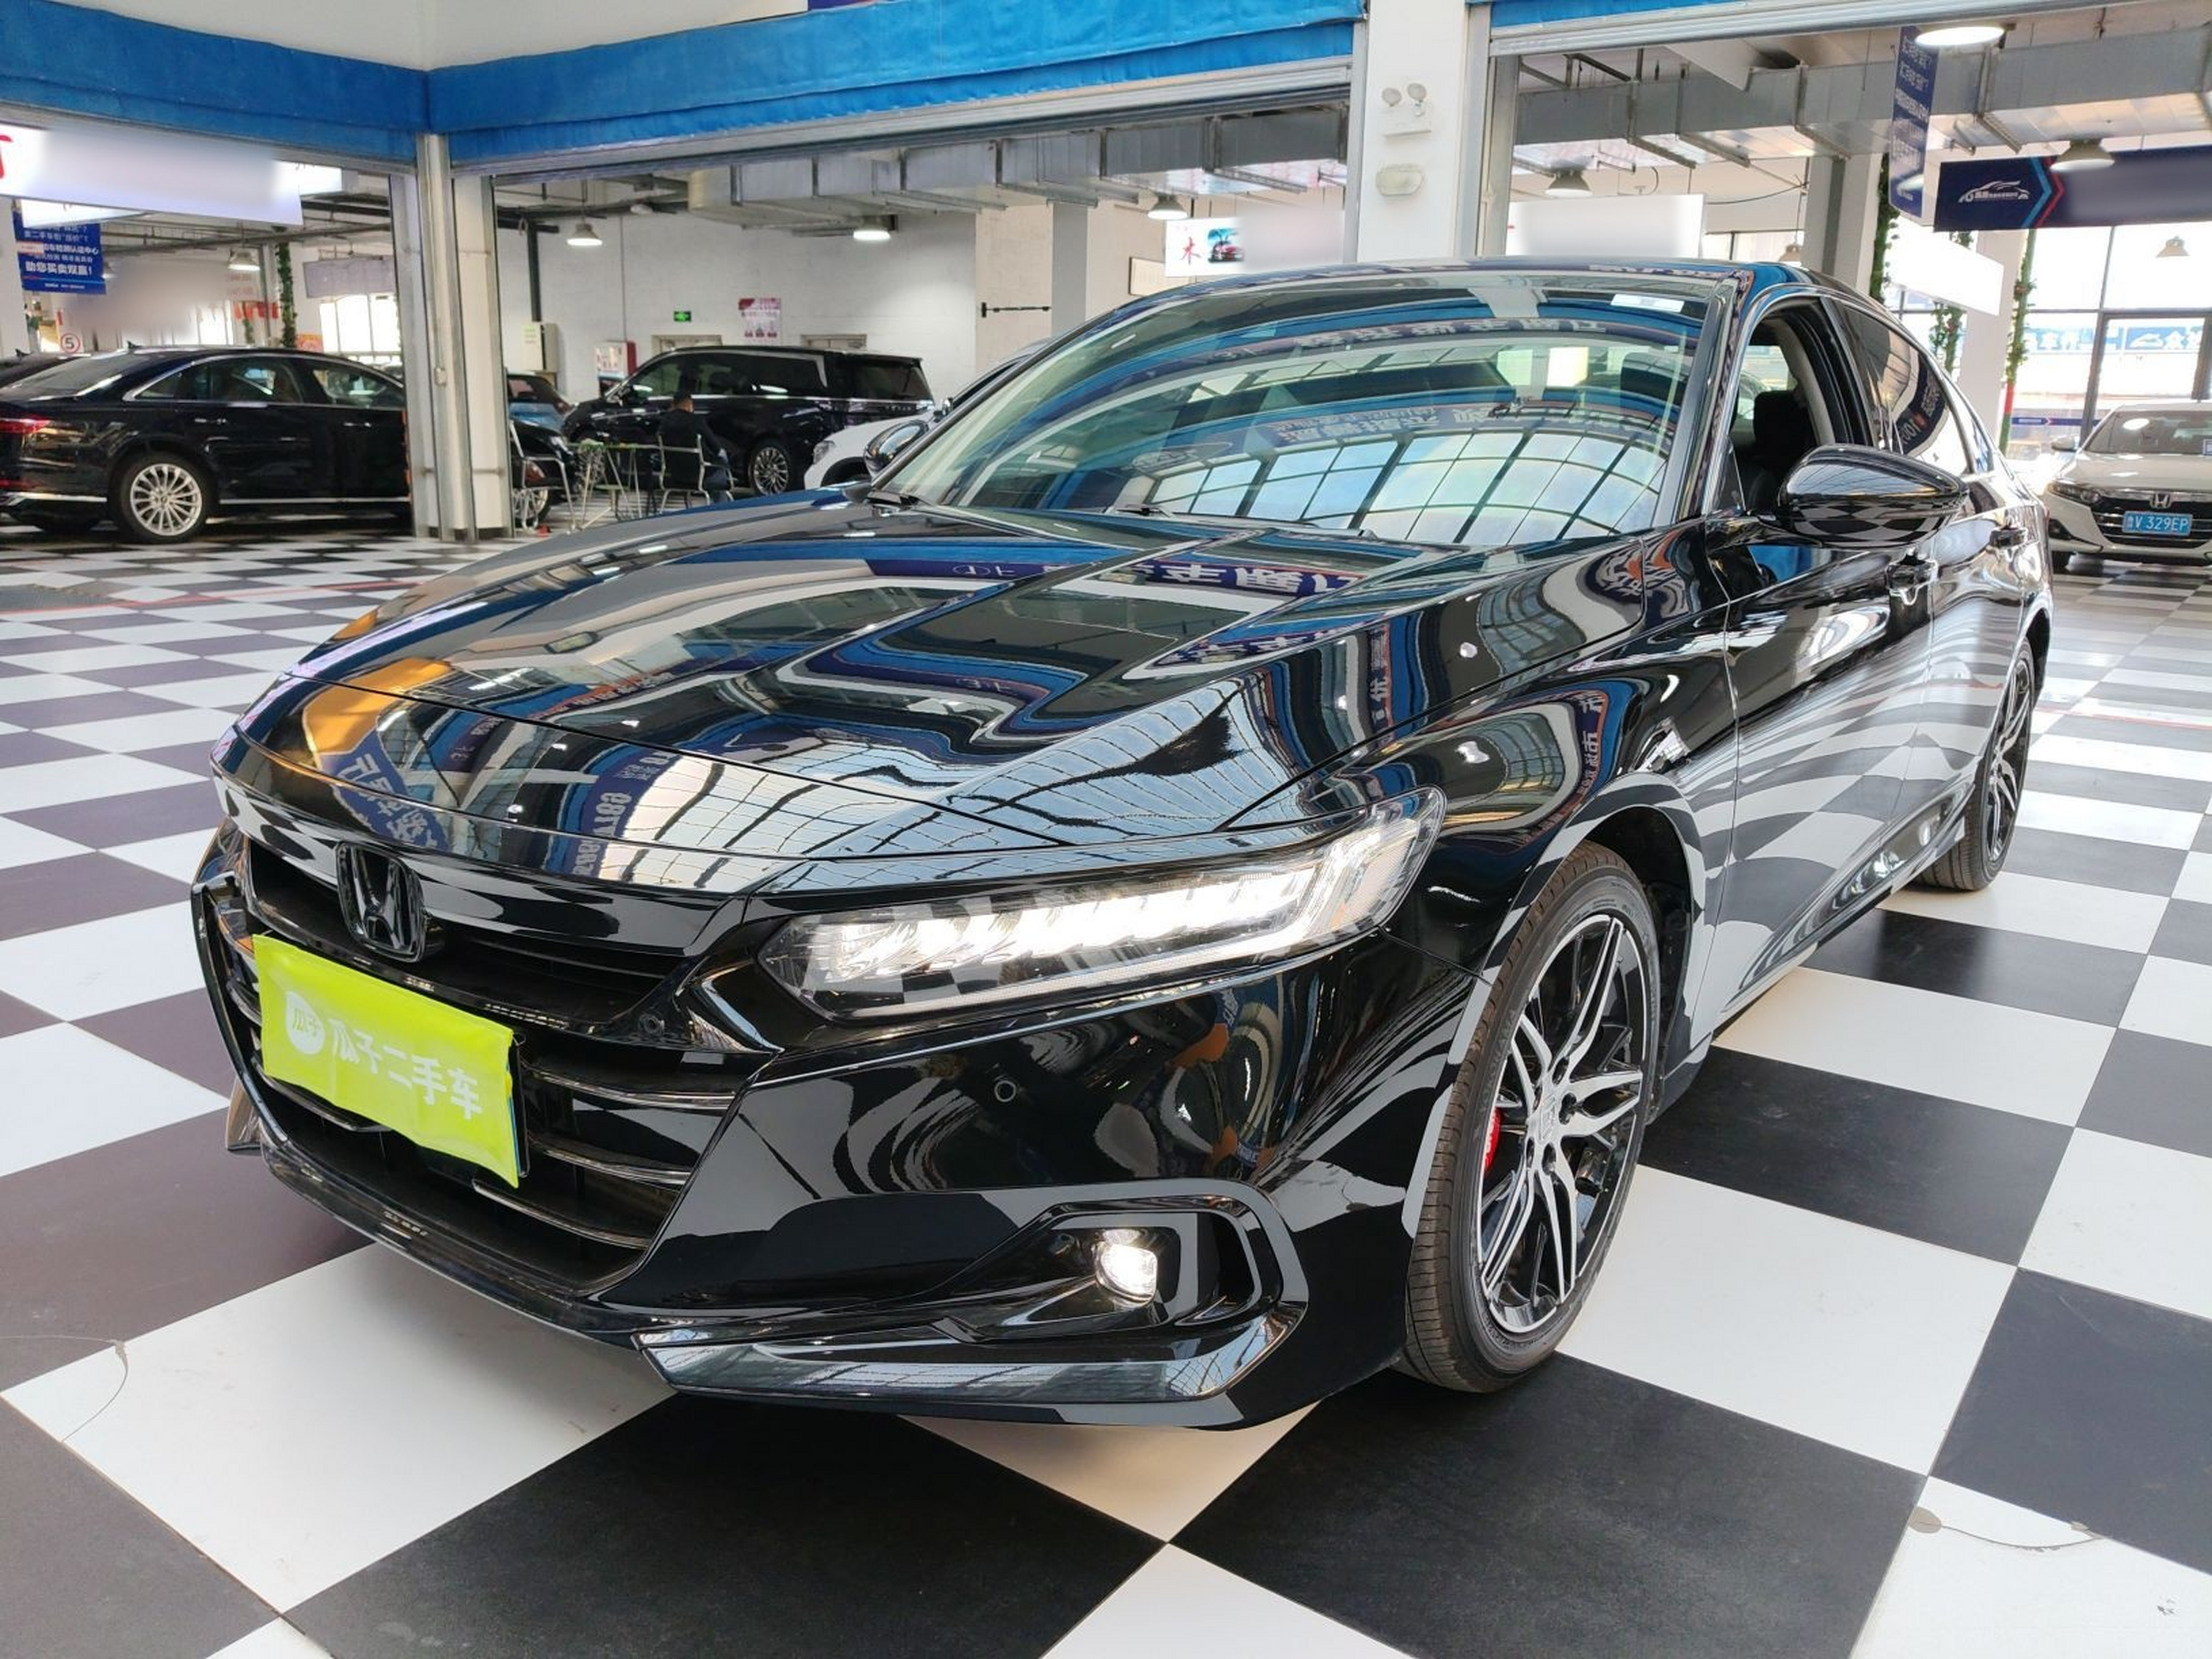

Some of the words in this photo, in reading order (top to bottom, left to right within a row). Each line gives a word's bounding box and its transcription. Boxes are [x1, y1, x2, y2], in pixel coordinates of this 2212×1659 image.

[65, 337, 74, 350] 5
[328, 1018, 482, 1120] 瓜子二手车
